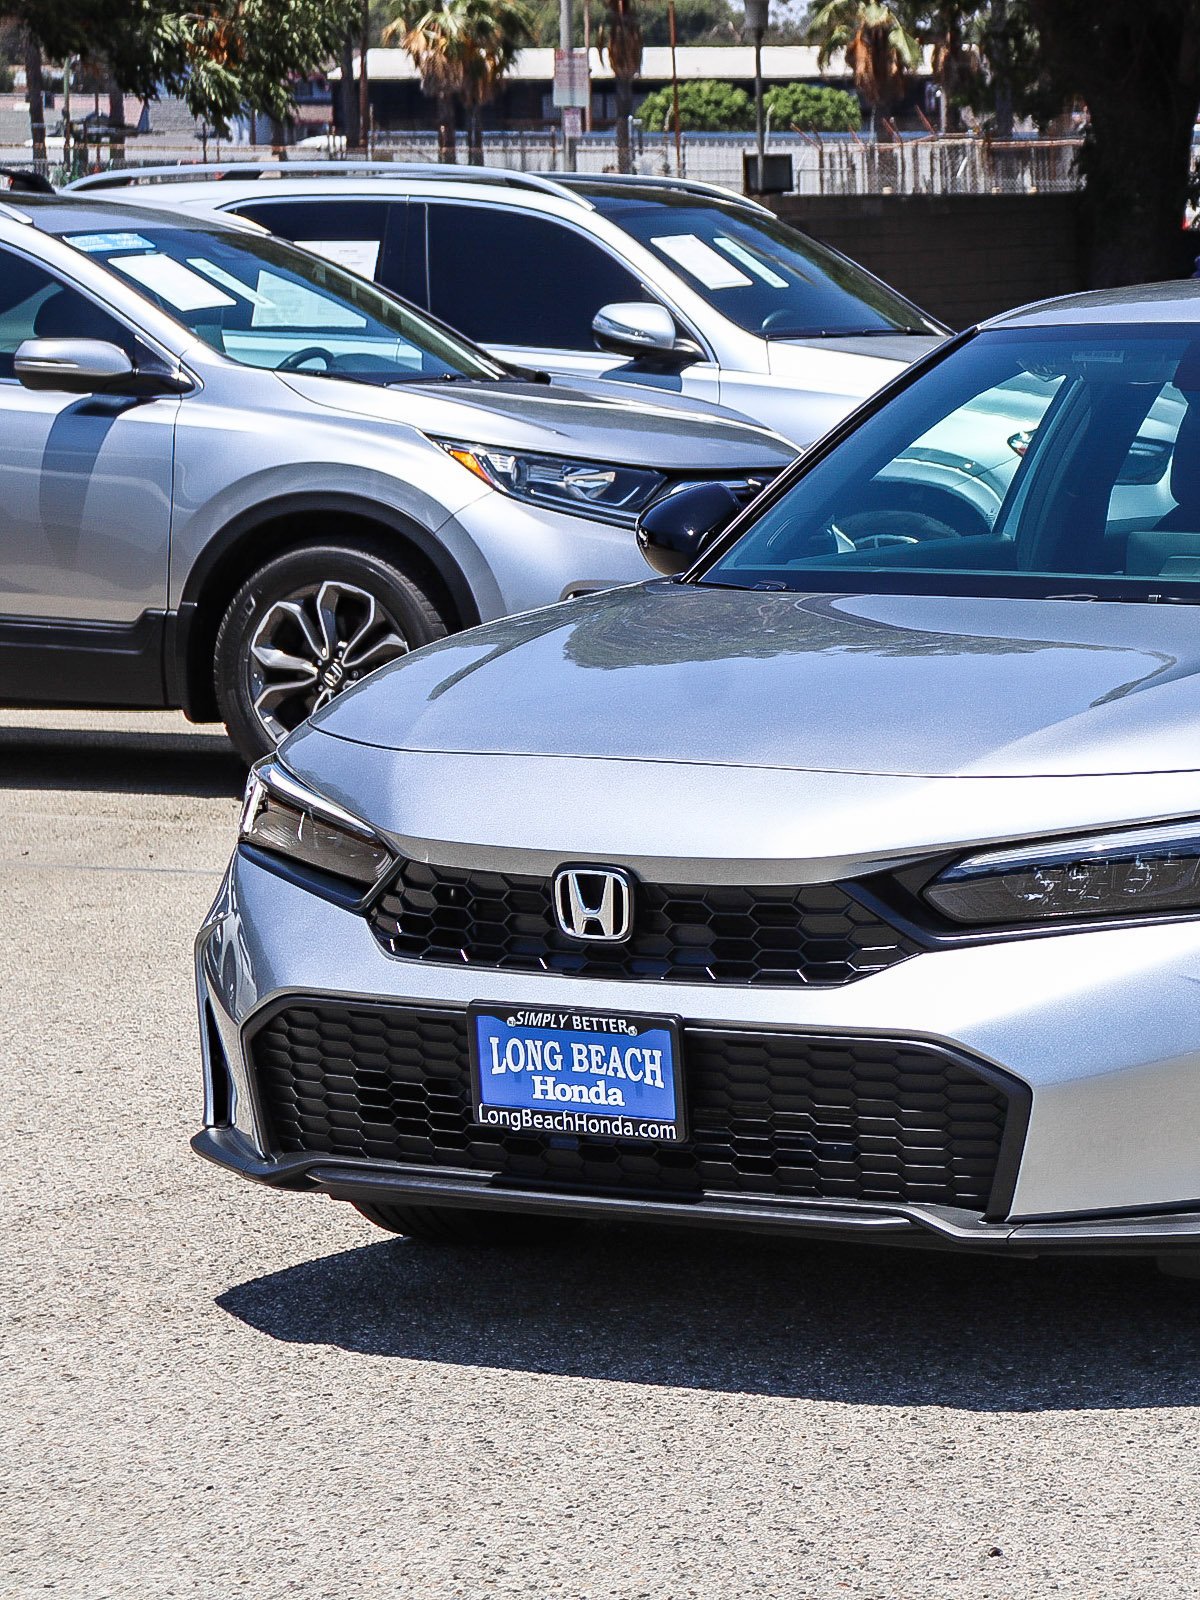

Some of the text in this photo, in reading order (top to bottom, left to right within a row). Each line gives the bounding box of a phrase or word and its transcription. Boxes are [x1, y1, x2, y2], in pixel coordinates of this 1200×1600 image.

[516, 1011, 628, 1033] SIMPLY BETTER
[489, 1036, 665, 1089] LONG BEACH
[531, 1075, 626, 1107] Honda
[478, 1102, 677, 1140] LongBeachHonda.com
